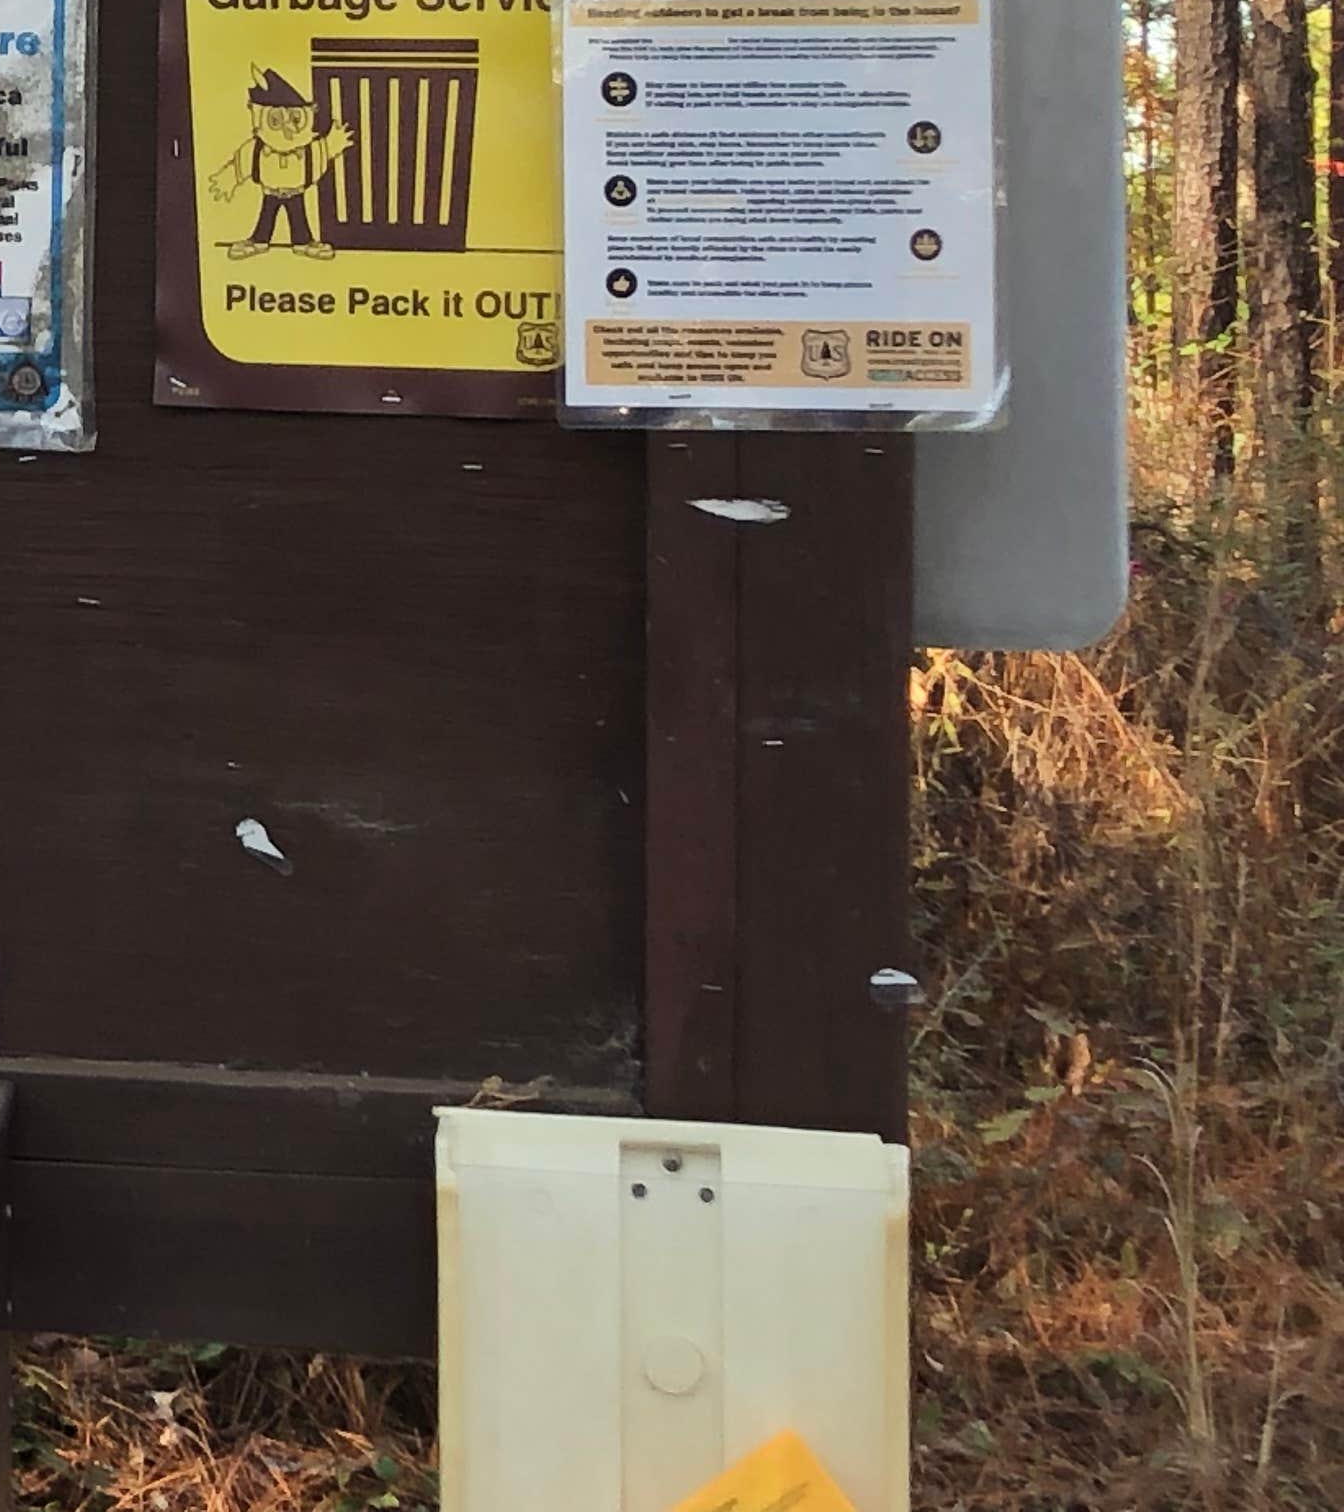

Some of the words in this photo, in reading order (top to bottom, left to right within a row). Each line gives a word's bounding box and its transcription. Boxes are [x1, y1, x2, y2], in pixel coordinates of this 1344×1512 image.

[226, 284, 336, 314] Please
[348, 288, 431, 318] Pack
[443, 289, 464, 319] it
[866, 330, 922, 348] RIDE
[928, 330, 963, 348] ON
